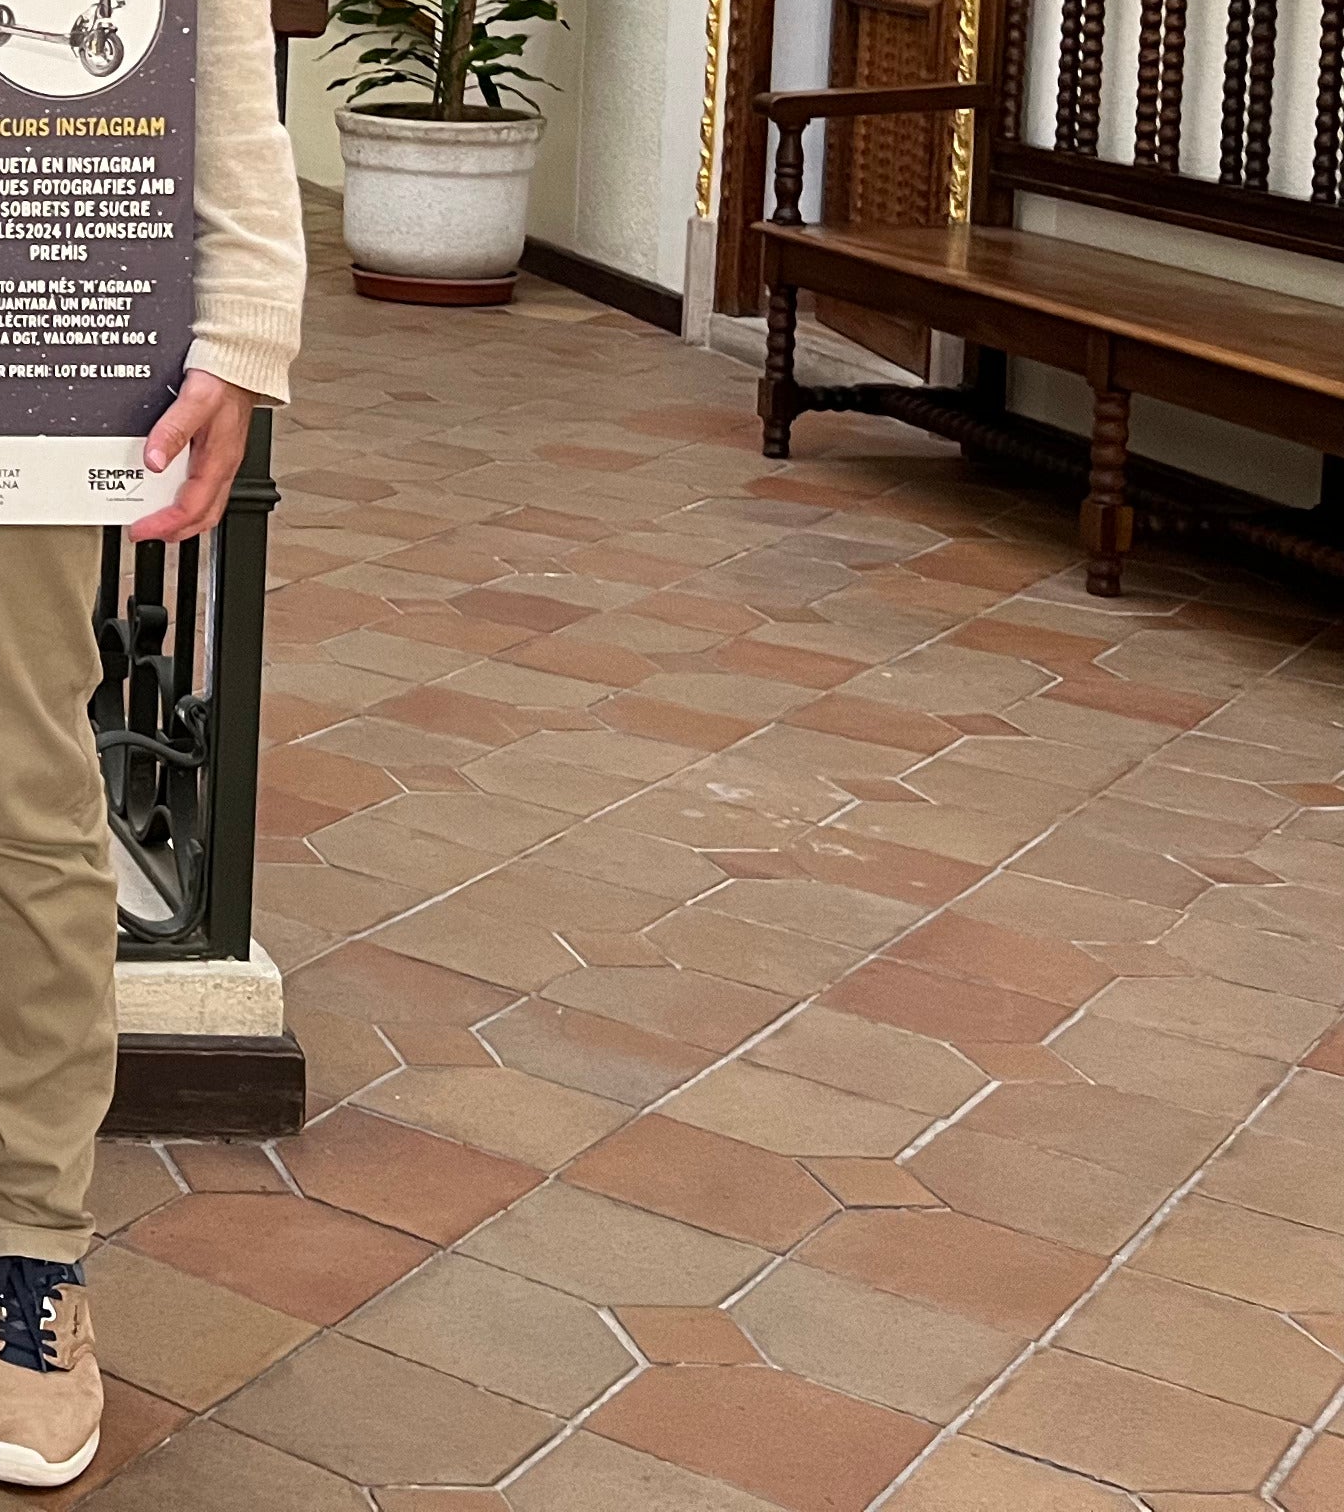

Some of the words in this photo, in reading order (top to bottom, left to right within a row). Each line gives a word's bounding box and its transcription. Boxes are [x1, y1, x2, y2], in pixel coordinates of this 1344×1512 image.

[57, 117, 165, 136] INSTAGRAM
[42, 157, 63, 173] EN
[67, 157, 155, 173] INSTAGRAM
[33, 179, 136, 195] FOTOGRAFIES
[140, 178, 175, 195] AMB
[0, 201, 70, 217] SOBRETS
[74, 201, 95, 217] DE
[99, 201, 150, 217] SUCRE
[66, 223, 71, 238] I
[74, 222, 174, 238] ACONSEGUIX
[29, 245, 88, 261] PREMIS
[17, 280, 45, 293] AMB
[49, 277, 76, 293] MÉS
[61, 297, 79, 310] UN
[81, 297, 132, 310] PATINET
[53, 315, 130, 327] HOMOLOGAT
[43, 332, 98, 344] VALORAT
[101, 332, 120, 344] EN
[122, 332, 145, 344] 600
[148, 332, 158, 344] €
[9, 365, 51, 377] PREMI:
[54, 365, 78, 377] LOT
[80, 365, 97, 377] DE
[100, 365, 151, 378] LLIBRES
[88, 469, 144, 480] SEMPRE
[88, 481, 126, 490] TEUA
